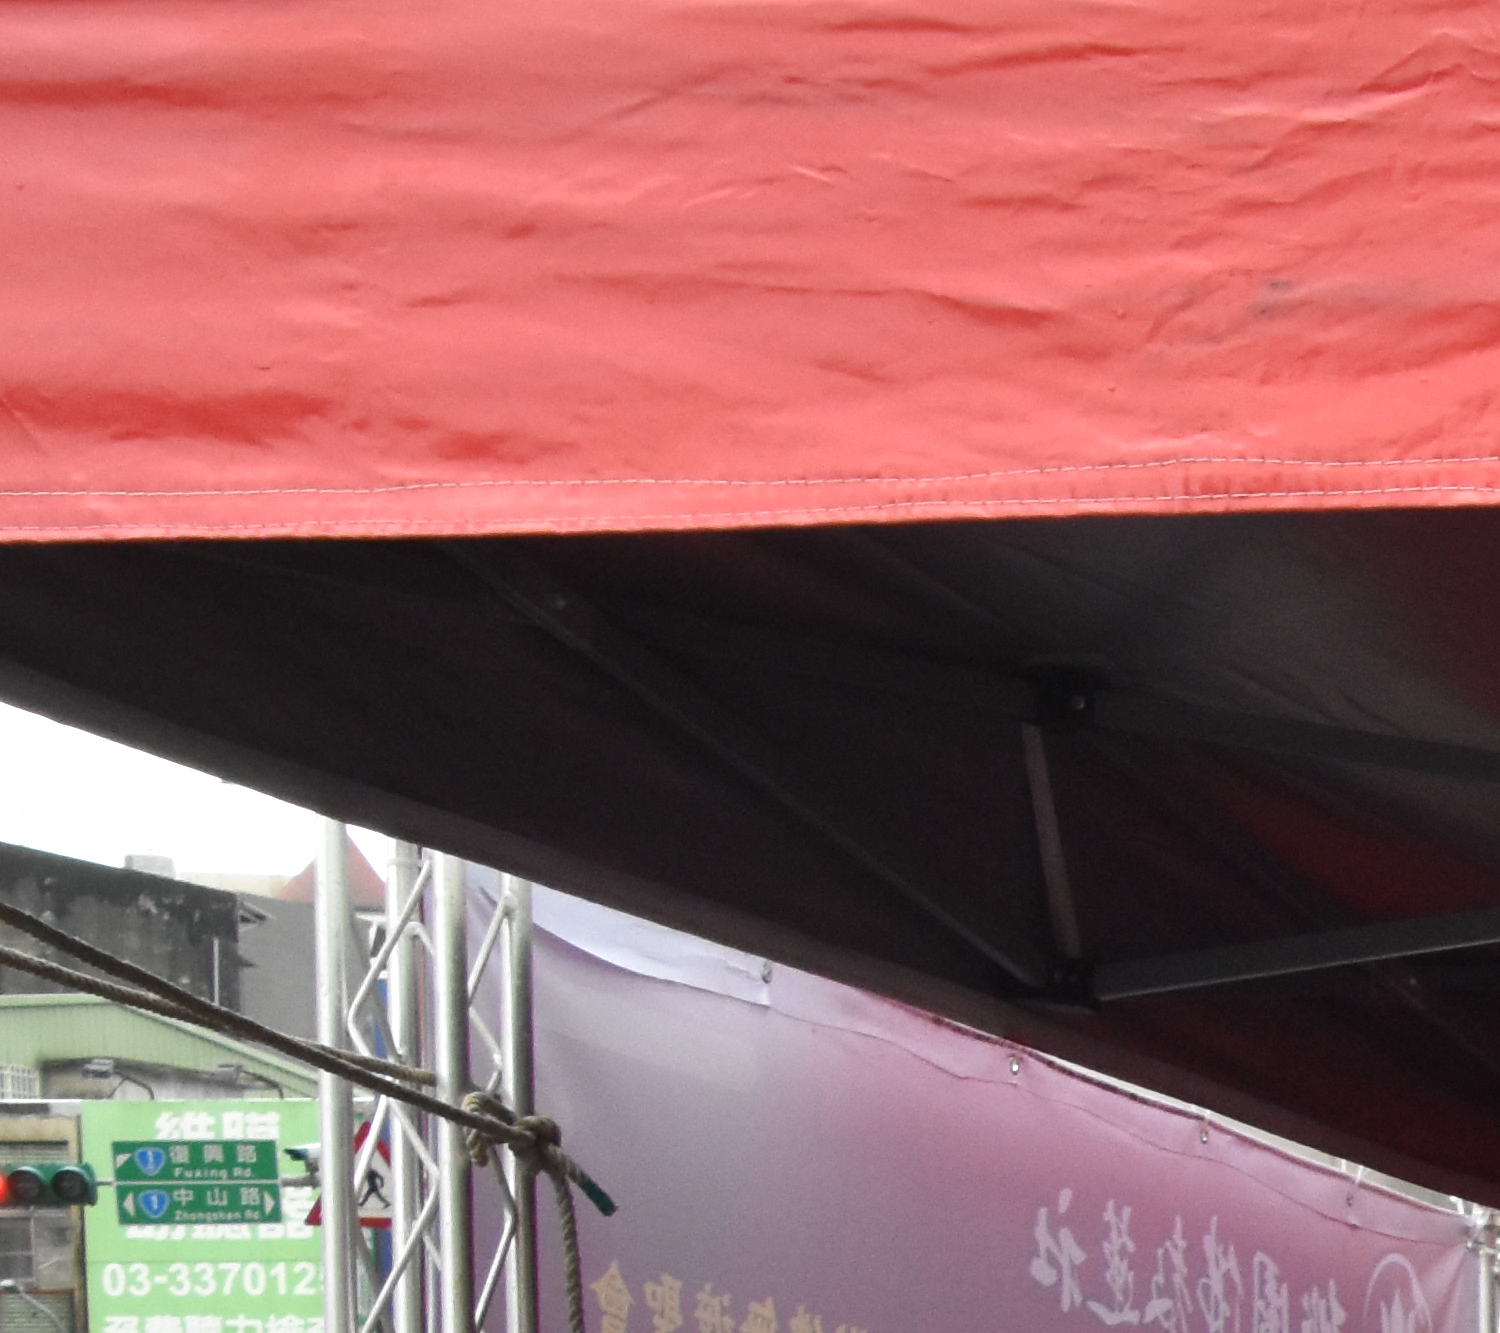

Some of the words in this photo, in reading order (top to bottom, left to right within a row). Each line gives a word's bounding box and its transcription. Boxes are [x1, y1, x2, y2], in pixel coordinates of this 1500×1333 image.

[169, 1144, 257, 1165] 復興路
[174, 1168, 228, 1179] Fuxing
[173, 1187, 260, 1206] 中山路
[102, 1262, 324, 1297] 03-337012
